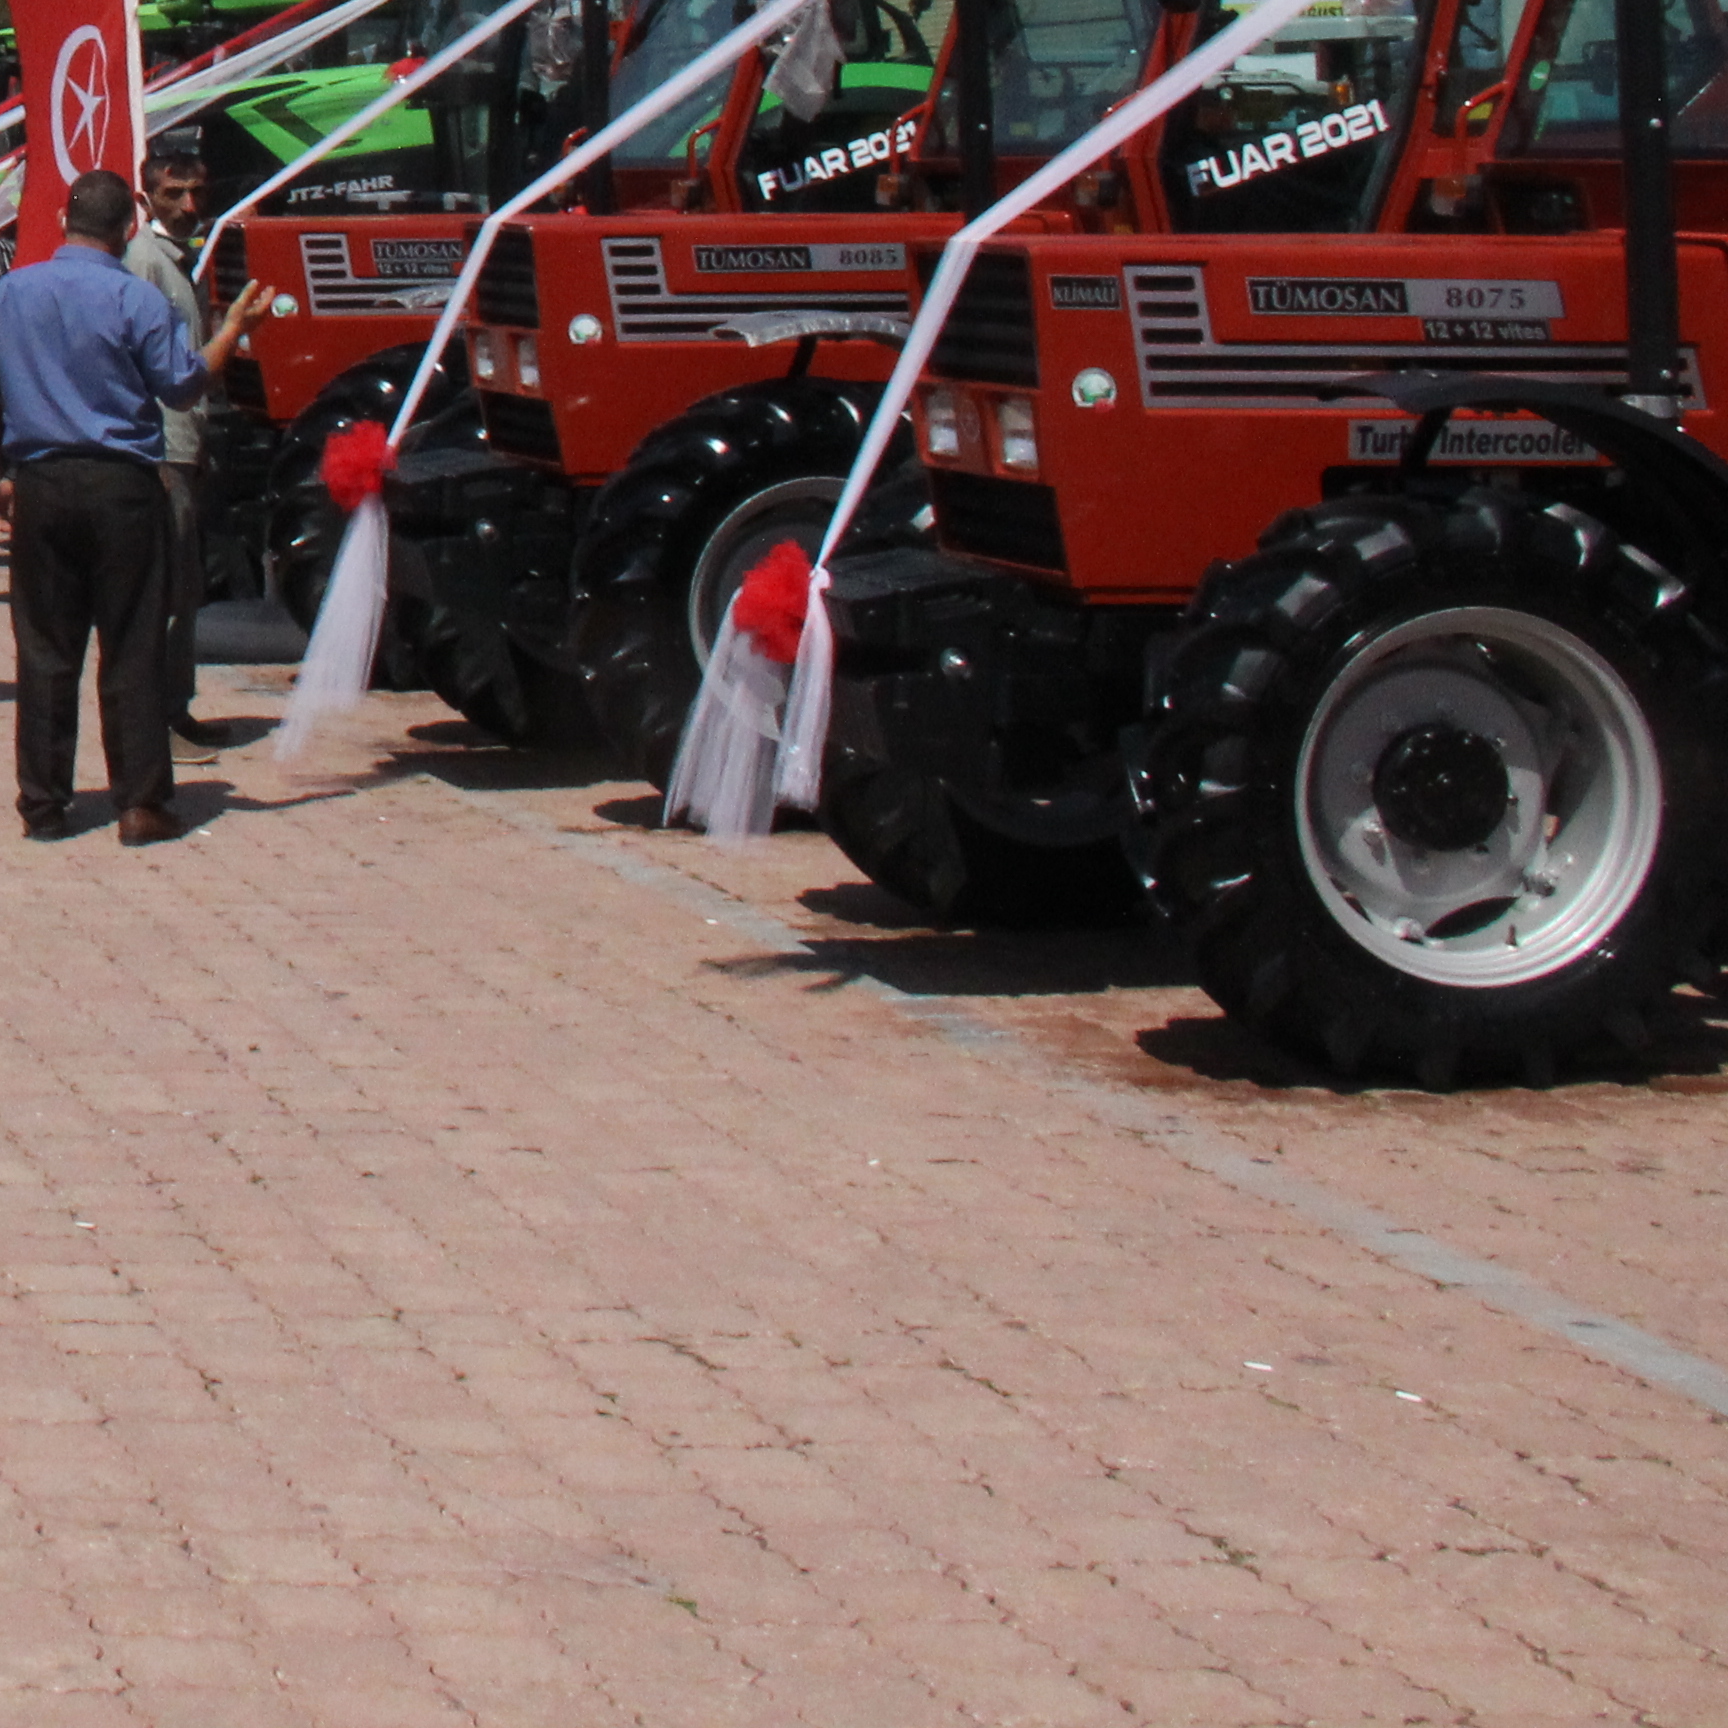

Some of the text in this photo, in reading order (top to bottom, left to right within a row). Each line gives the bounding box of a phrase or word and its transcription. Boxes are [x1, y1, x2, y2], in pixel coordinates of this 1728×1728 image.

[1185, 98, 1390, 197] FUAR 2021
[756, 146, 849, 201] FUAR
[1252, 279, 1527, 311] TÜMOSAN 8075
[1425, 322, 1450, 340] 12
[1469, 322, 1494, 340] 12
